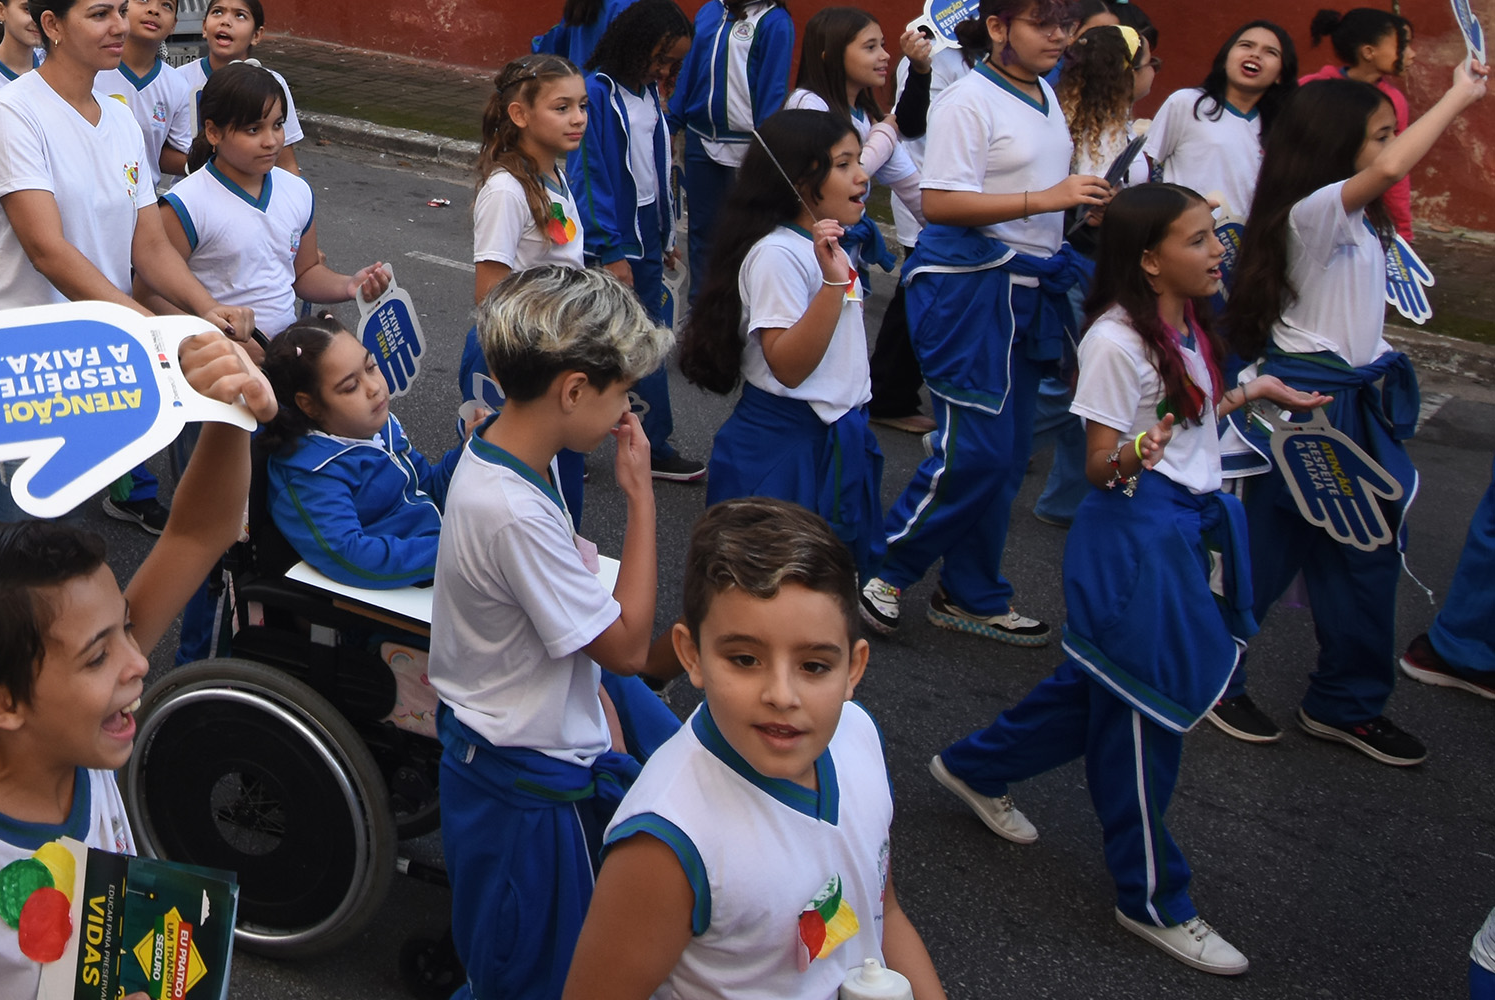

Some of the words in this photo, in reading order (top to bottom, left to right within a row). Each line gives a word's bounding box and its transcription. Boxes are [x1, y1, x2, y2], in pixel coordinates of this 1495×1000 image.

[935, 0, 964, 22] ATENÇÃO!
[939, 7, 969, 30] RESPEITE
[375, 330, 391, 360] PARE!
[377, 309, 398, 353] RESPEITE
[397, 335, 405, 346] A
[0, 346, 101, 374] FAIXA.
[107, 343, 129, 363] A
[3, 388, 142, 425] ATENÇÃO!
[1293, 441, 1305, 449] A
[1305, 441, 1341, 496] RESPEITE
[1320, 441, 1355, 497] ATENÇÃO!
[107, 884, 115, 922] EDUCAR
[82, 895, 106, 987] VIDAS
[105, 923, 113, 948] PARA
[166, 923, 174, 942] UM
[180, 930, 189, 946] EU
[152, 933, 164, 981] SEGURO
[175, 948, 188, 998] PRATICO
